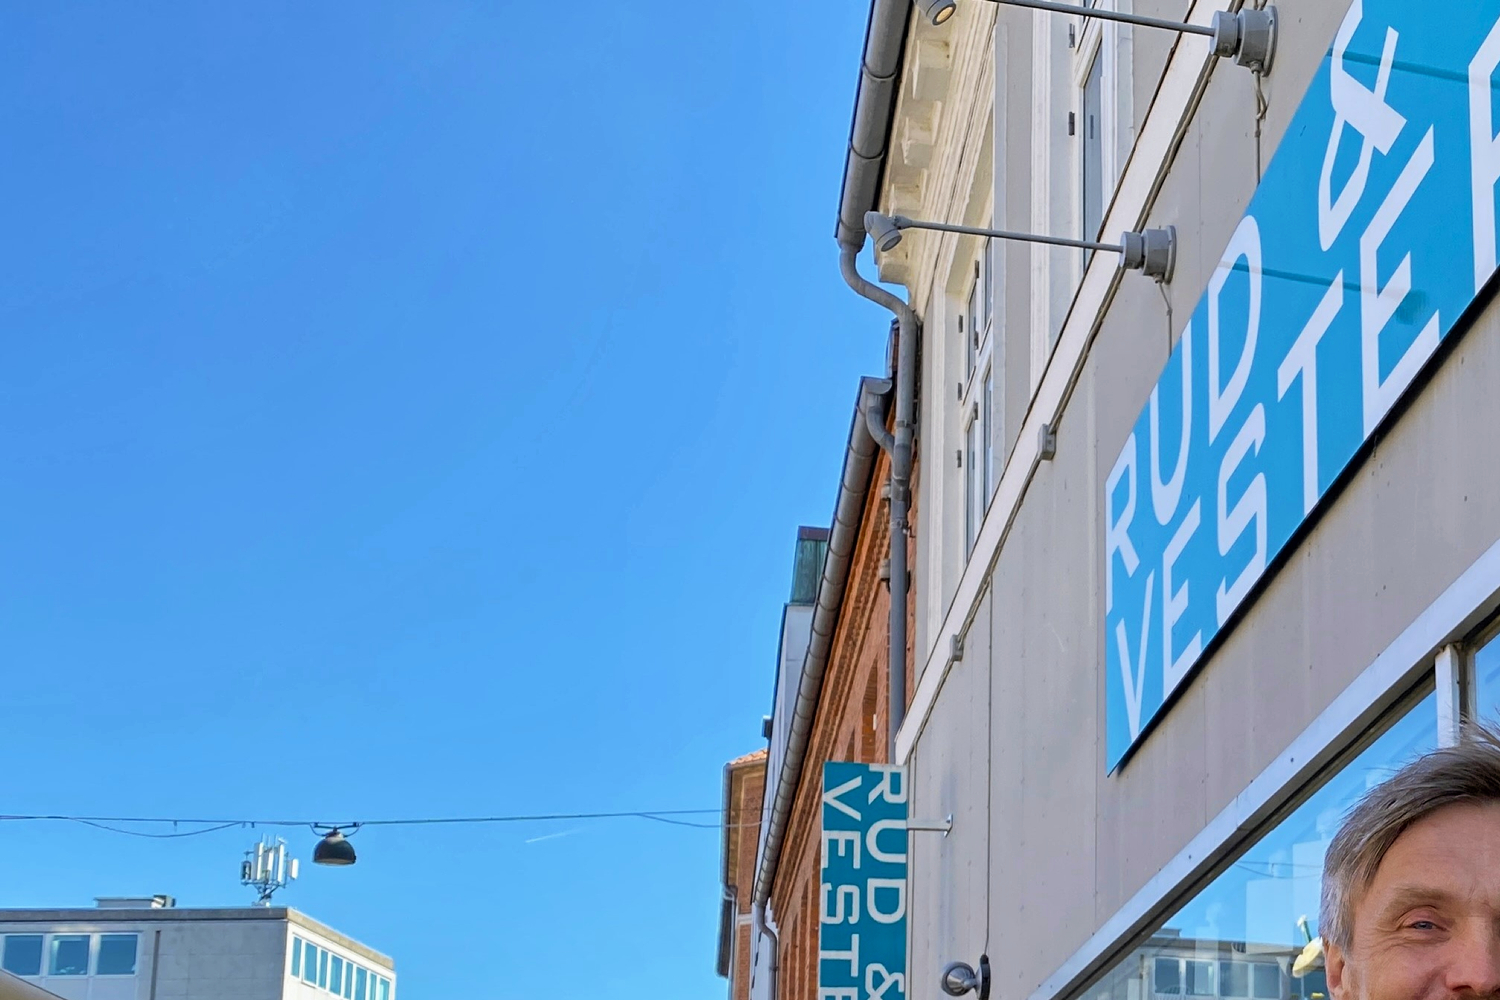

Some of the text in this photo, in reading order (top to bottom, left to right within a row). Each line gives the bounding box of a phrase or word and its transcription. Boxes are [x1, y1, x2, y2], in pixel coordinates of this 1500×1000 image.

[1106, 0, 1407, 616] RUD &
[866, 764, 907, 923] RUD
